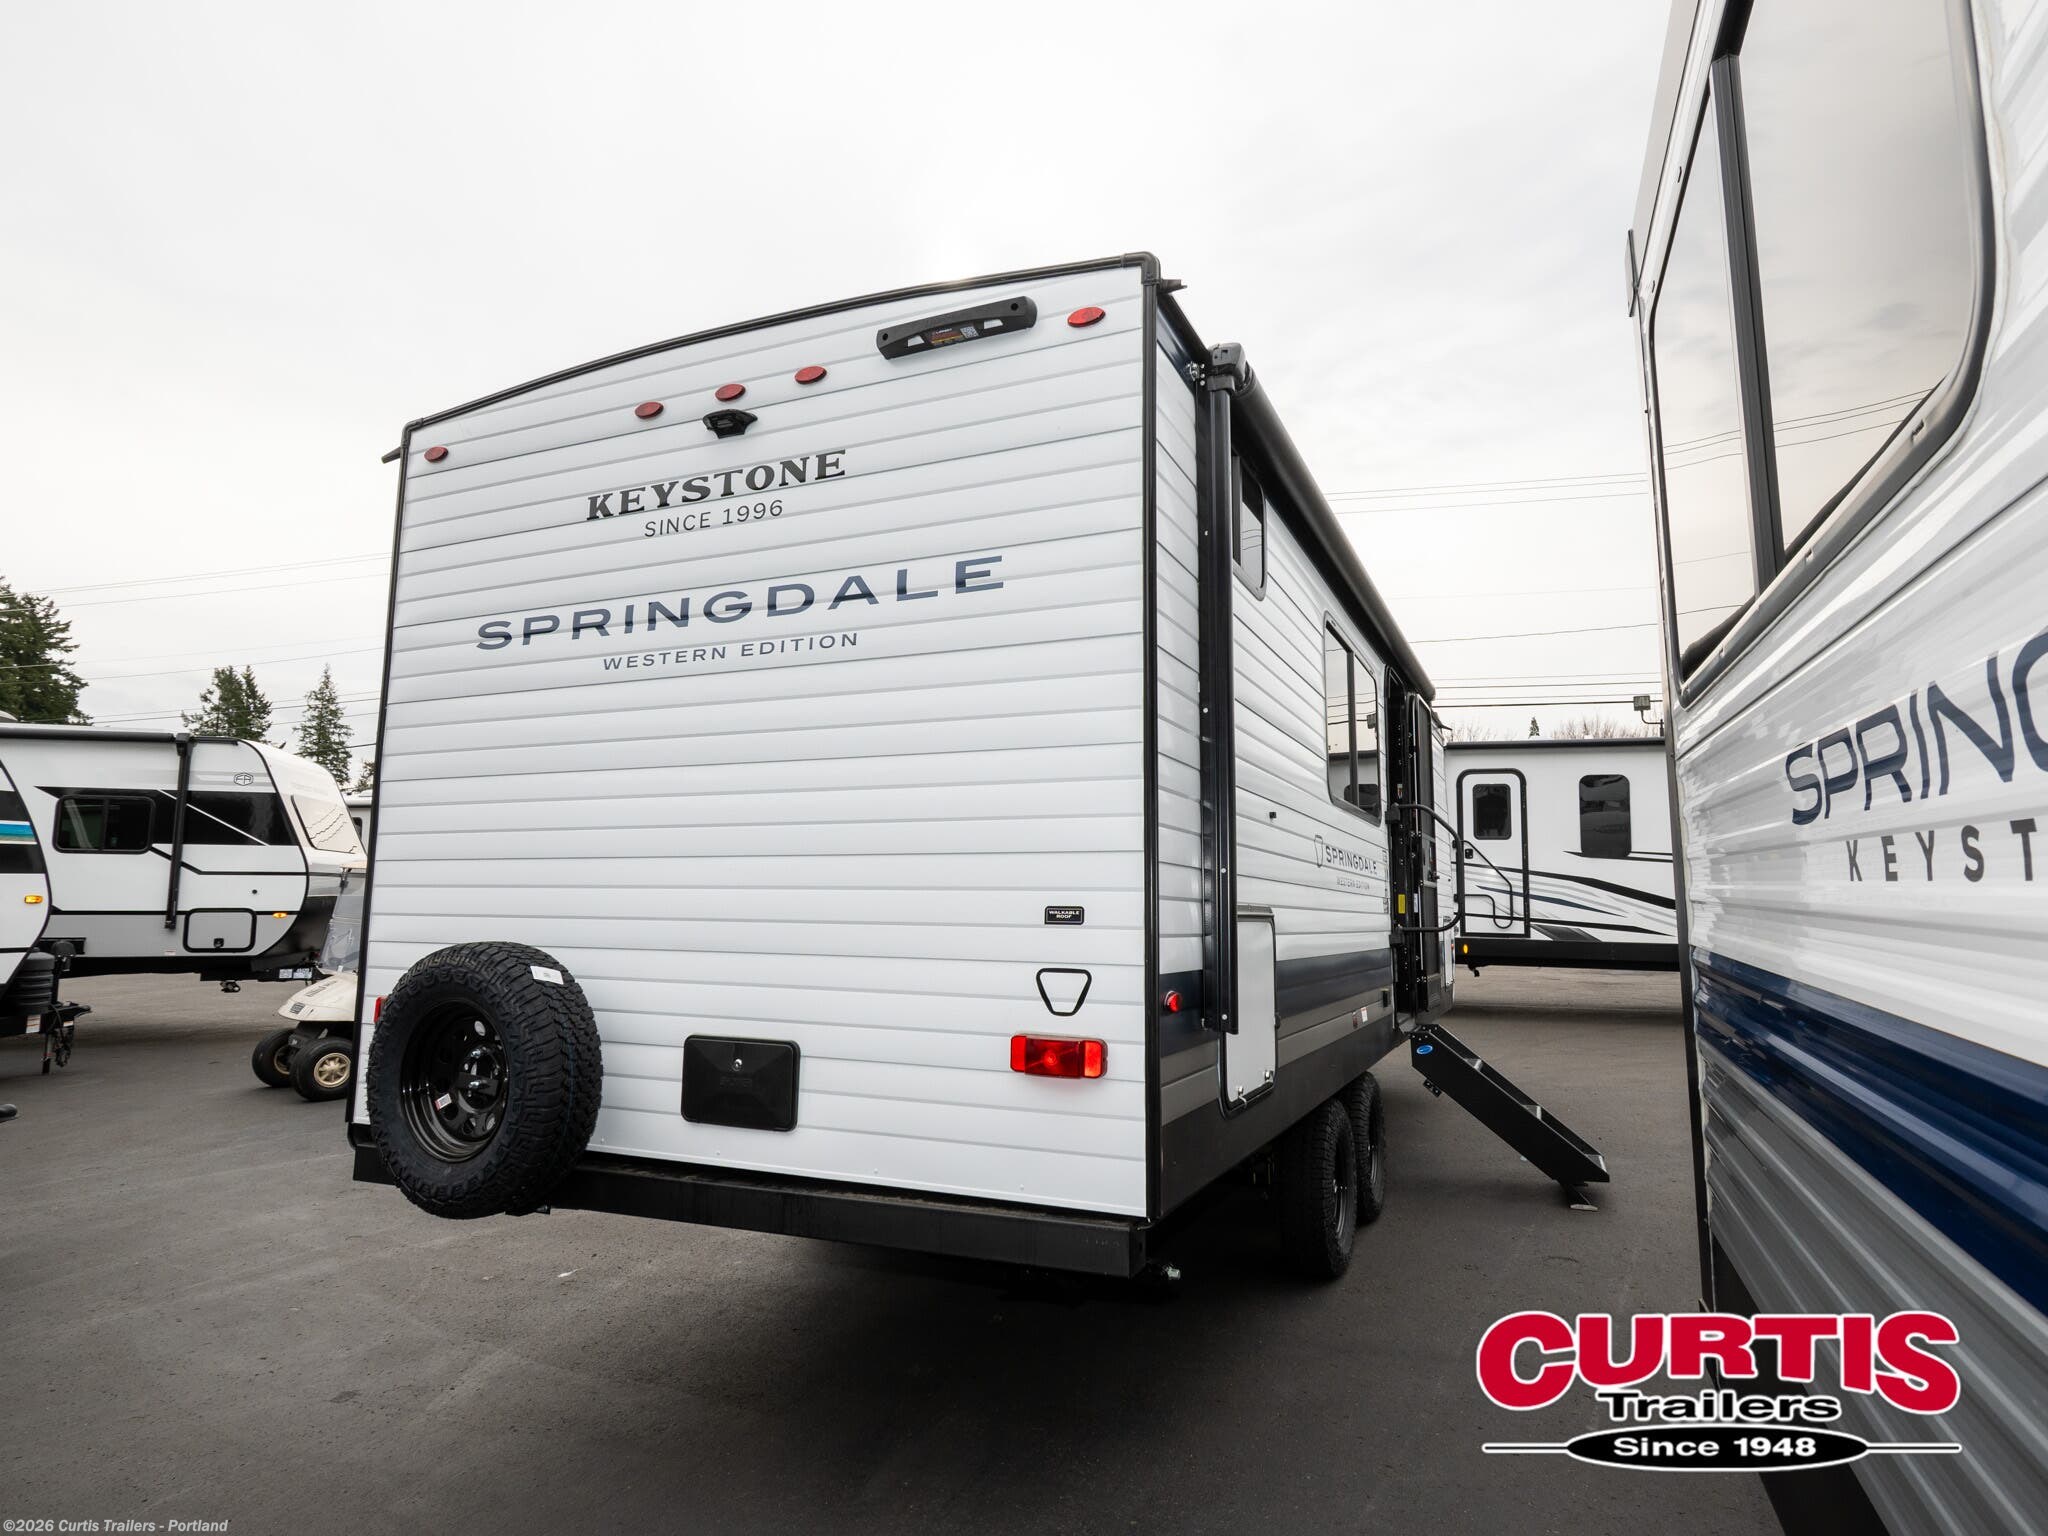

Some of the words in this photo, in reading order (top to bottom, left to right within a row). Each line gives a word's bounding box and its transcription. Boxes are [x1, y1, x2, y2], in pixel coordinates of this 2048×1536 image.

[586, 449, 846, 521] KEYSTONE
[643, 510, 712, 538] SINCE
[722, 499, 785, 526] 1996
[475, 555, 1005, 651] SPRINGDALE
[602, 646, 727, 671] WESTERN
[740, 632, 859, 658] EDITION
[1325, 845, 1378, 876] SPRINGDALE
[1845, 817, 2038, 883] KEYST
